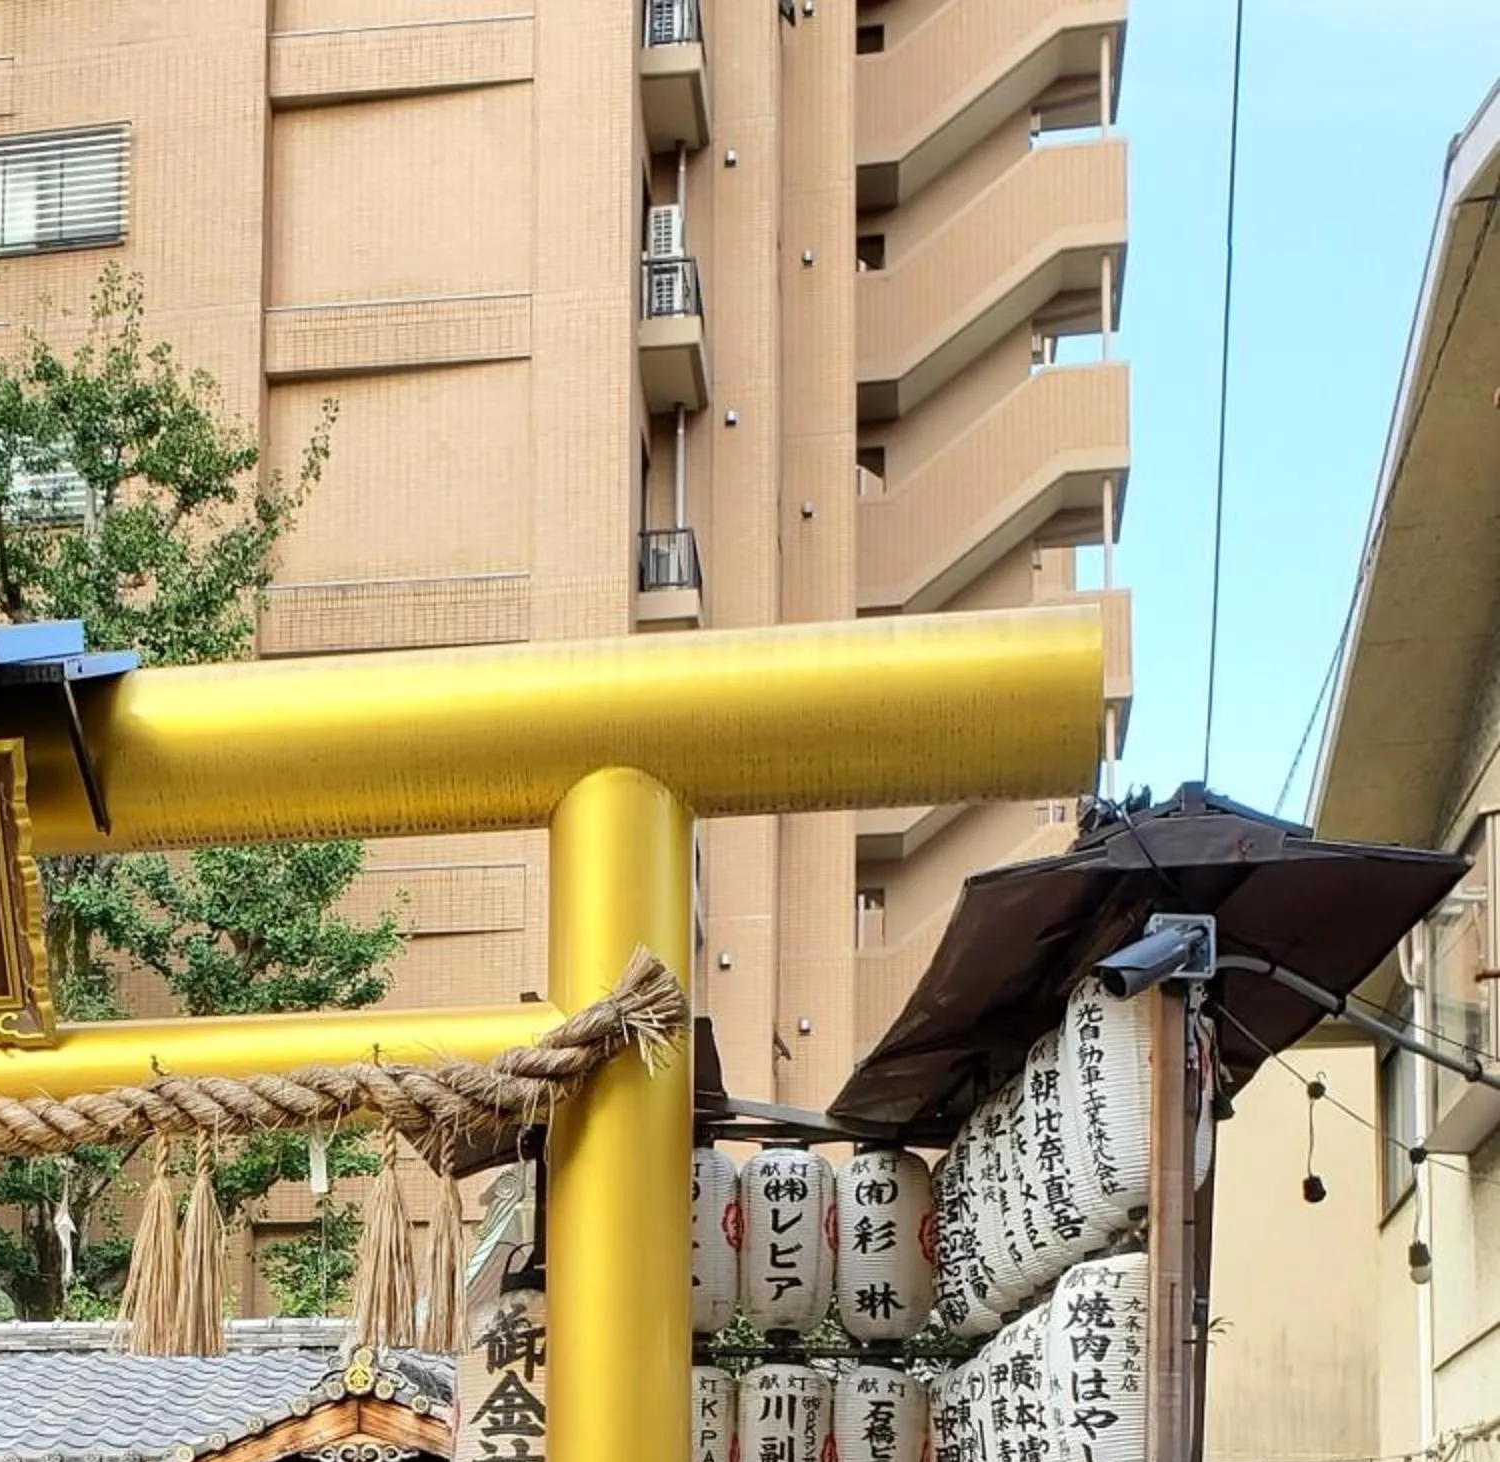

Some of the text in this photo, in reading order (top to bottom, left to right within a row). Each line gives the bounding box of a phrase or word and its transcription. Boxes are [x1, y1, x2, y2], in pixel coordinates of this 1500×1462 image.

[1029, 1068, 1090, 1243] 朝比奈真吾
